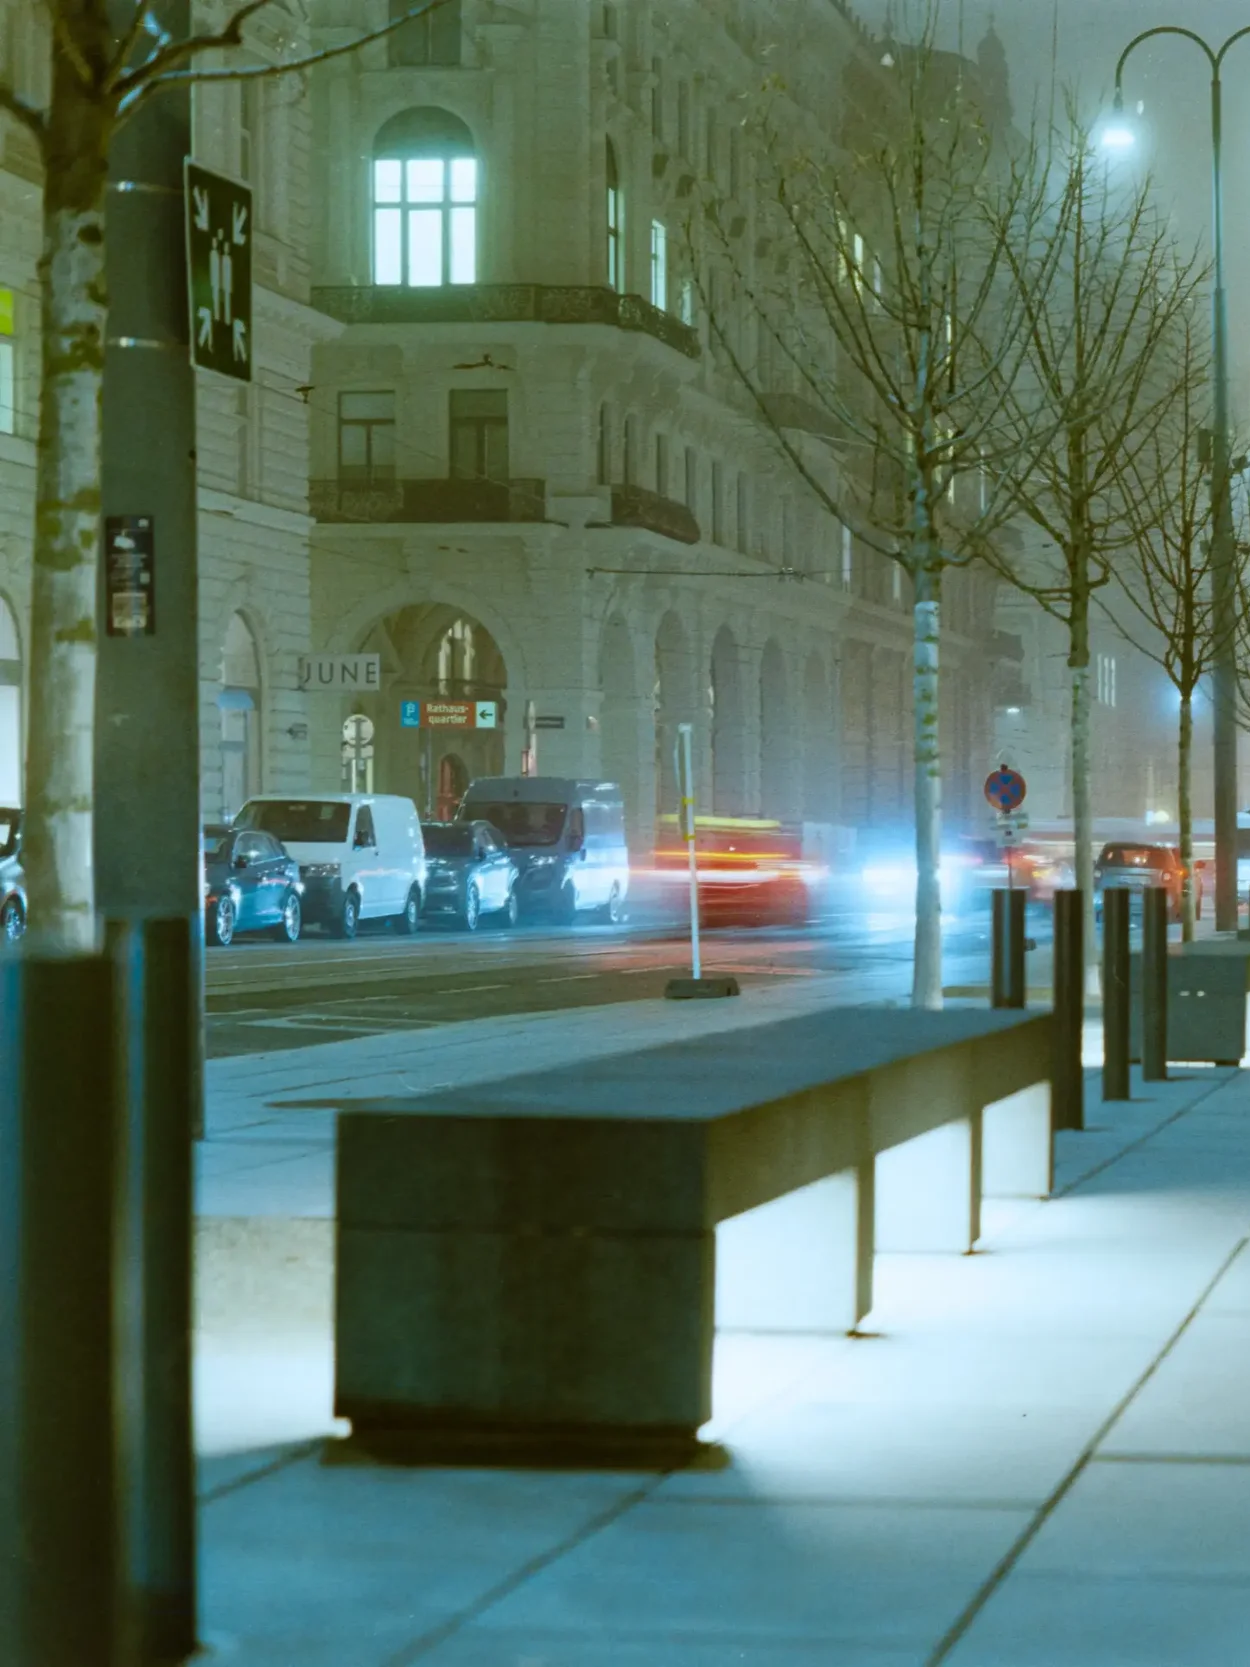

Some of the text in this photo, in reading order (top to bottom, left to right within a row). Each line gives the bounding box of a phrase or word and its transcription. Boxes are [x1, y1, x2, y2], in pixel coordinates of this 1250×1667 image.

[303, 662, 377, 684] JUNE
[426, 704, 469, 713] Rathaus-
[428, 715, 467, 725] quartier
